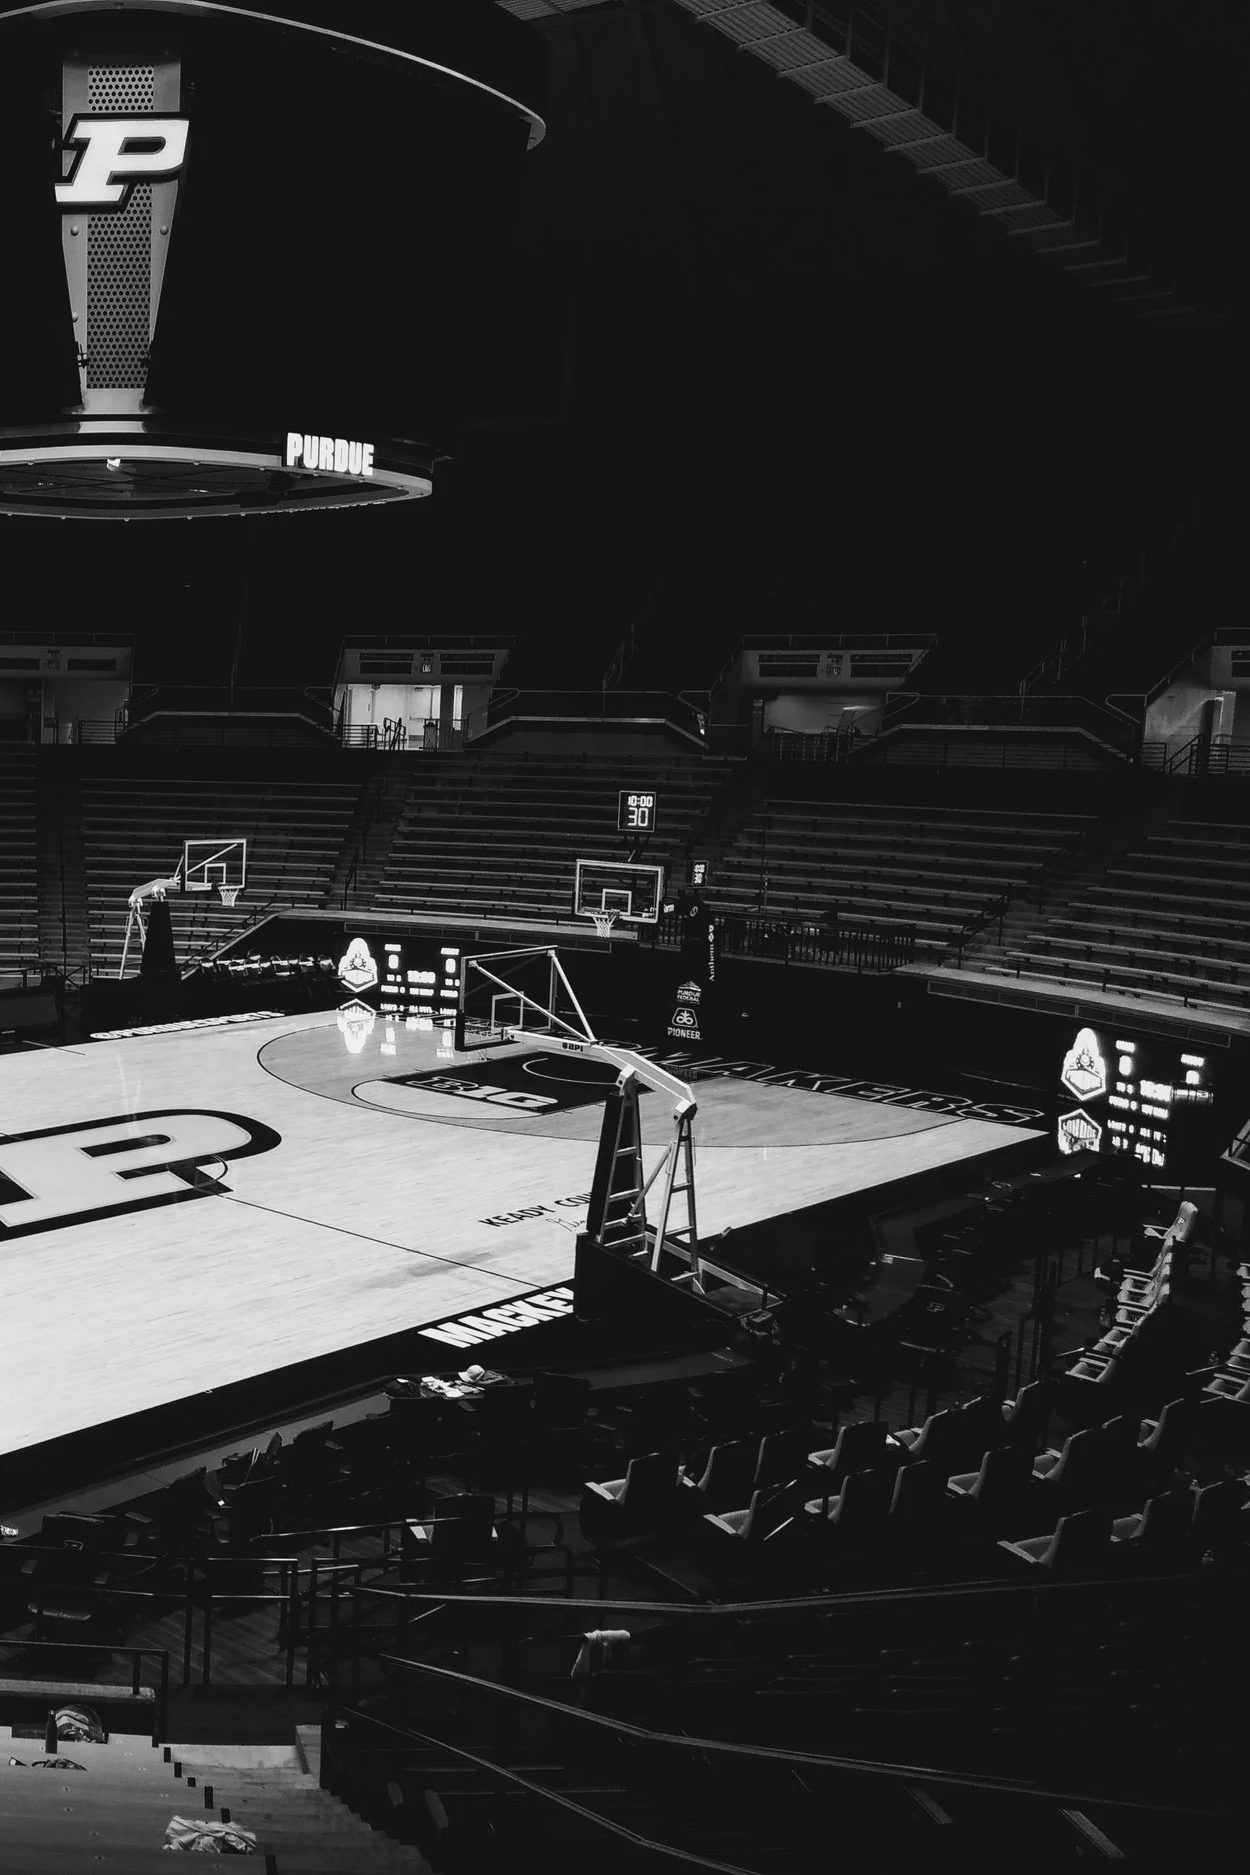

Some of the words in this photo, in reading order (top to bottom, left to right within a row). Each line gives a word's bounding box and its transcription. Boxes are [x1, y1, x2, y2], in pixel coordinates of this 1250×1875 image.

[53, 112, 190, 211] P
[286, 432, 375, 476] PURDUE
[628, 795, 653, 807] 10:00
[627, 807, 649, 827] 30
[667, 1026, 701, 1040] PIONEER
[477, 1204, 557, 1228] KEADY
